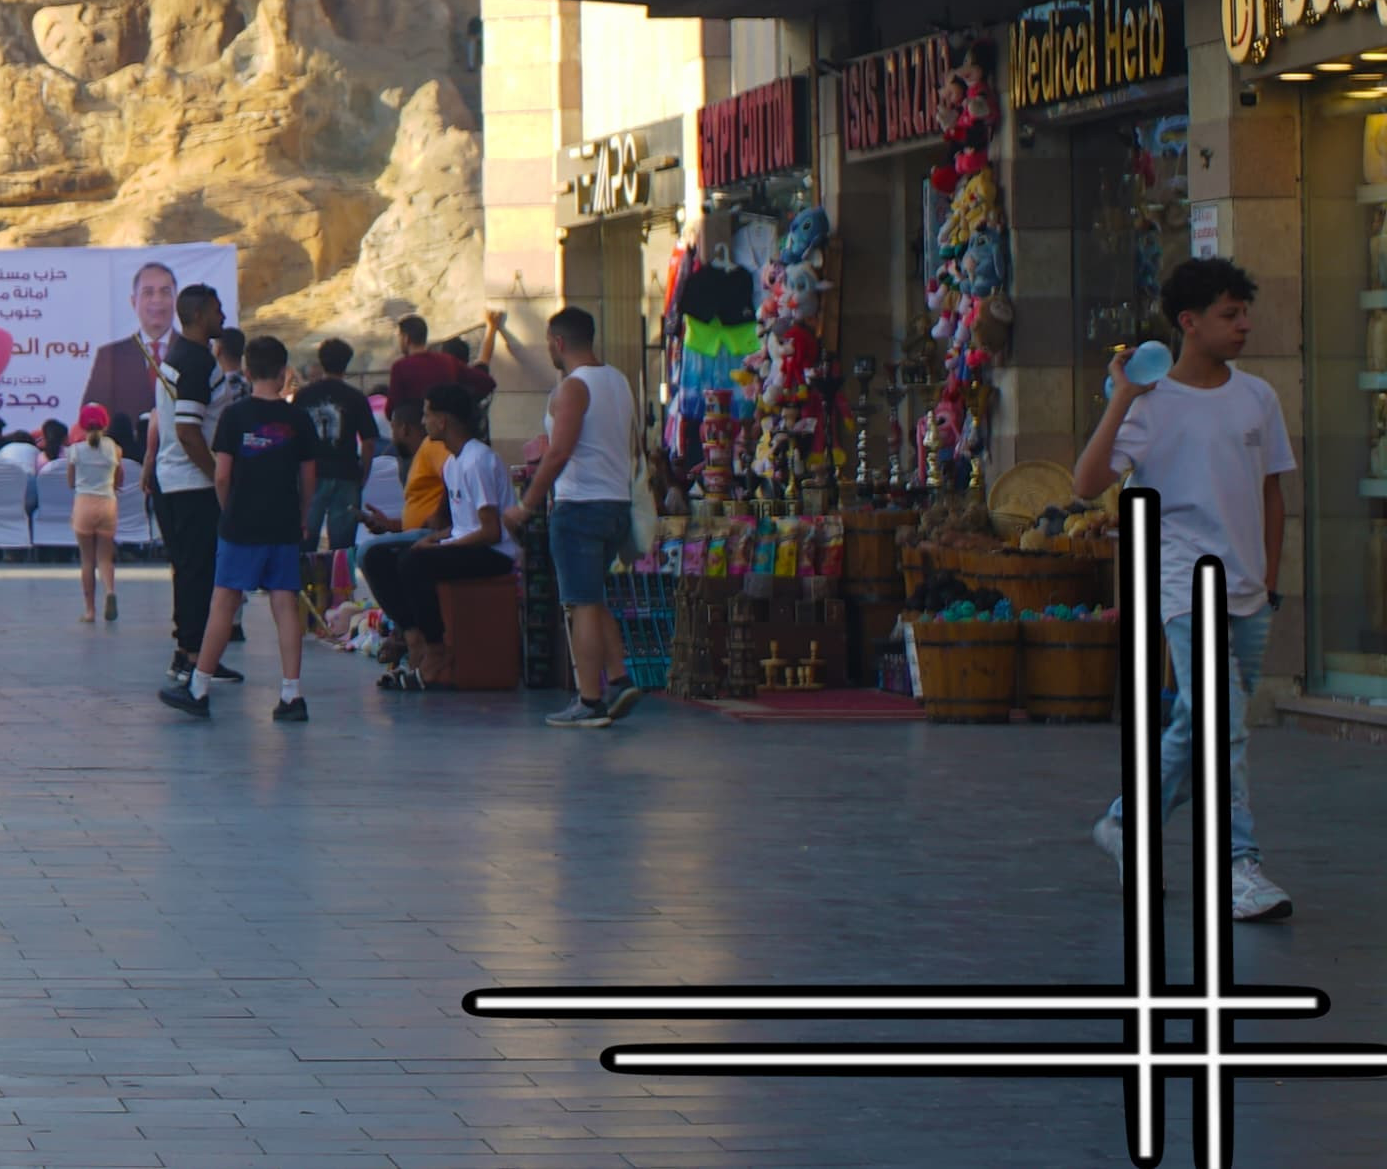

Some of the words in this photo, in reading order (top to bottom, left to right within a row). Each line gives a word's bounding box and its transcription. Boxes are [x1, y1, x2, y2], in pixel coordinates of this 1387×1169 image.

[738, 76, 795, 178] COTTON
[843, 56, 880, 151] ISIS
[34, 269, 67, 284] حزب
[45, 338, 90, 359] يوم
